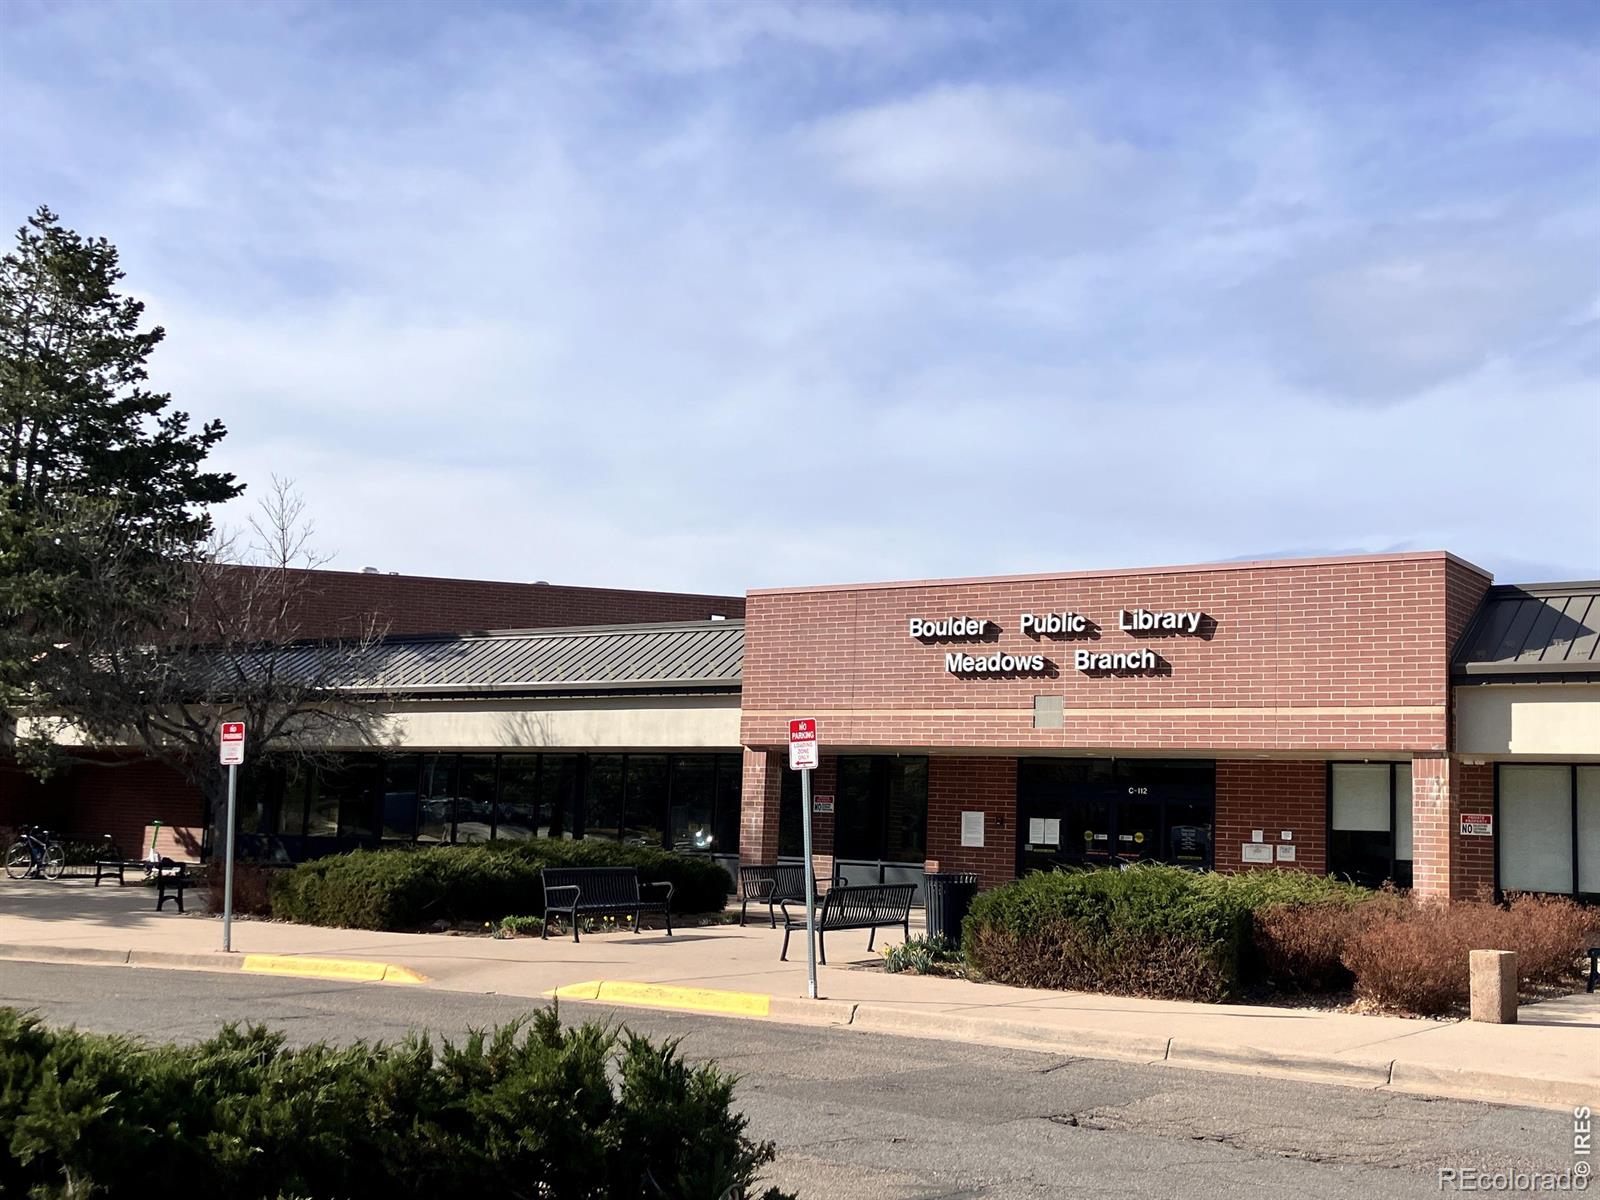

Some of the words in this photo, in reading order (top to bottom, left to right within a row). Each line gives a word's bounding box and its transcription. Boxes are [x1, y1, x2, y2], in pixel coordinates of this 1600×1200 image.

[909, 617, 988, 638] Boulder
[1020, 612, 1086, 634] Public
[1119, 609, 1201, 633] Library
[945, 652, 1044, 673] Meadows
[1074, 648, 1155, 671] Branch
[799, 722, 807, 731] NO
[791, 731, 814, 740] PARKING
[1462, 824, 1473, 833] NO
